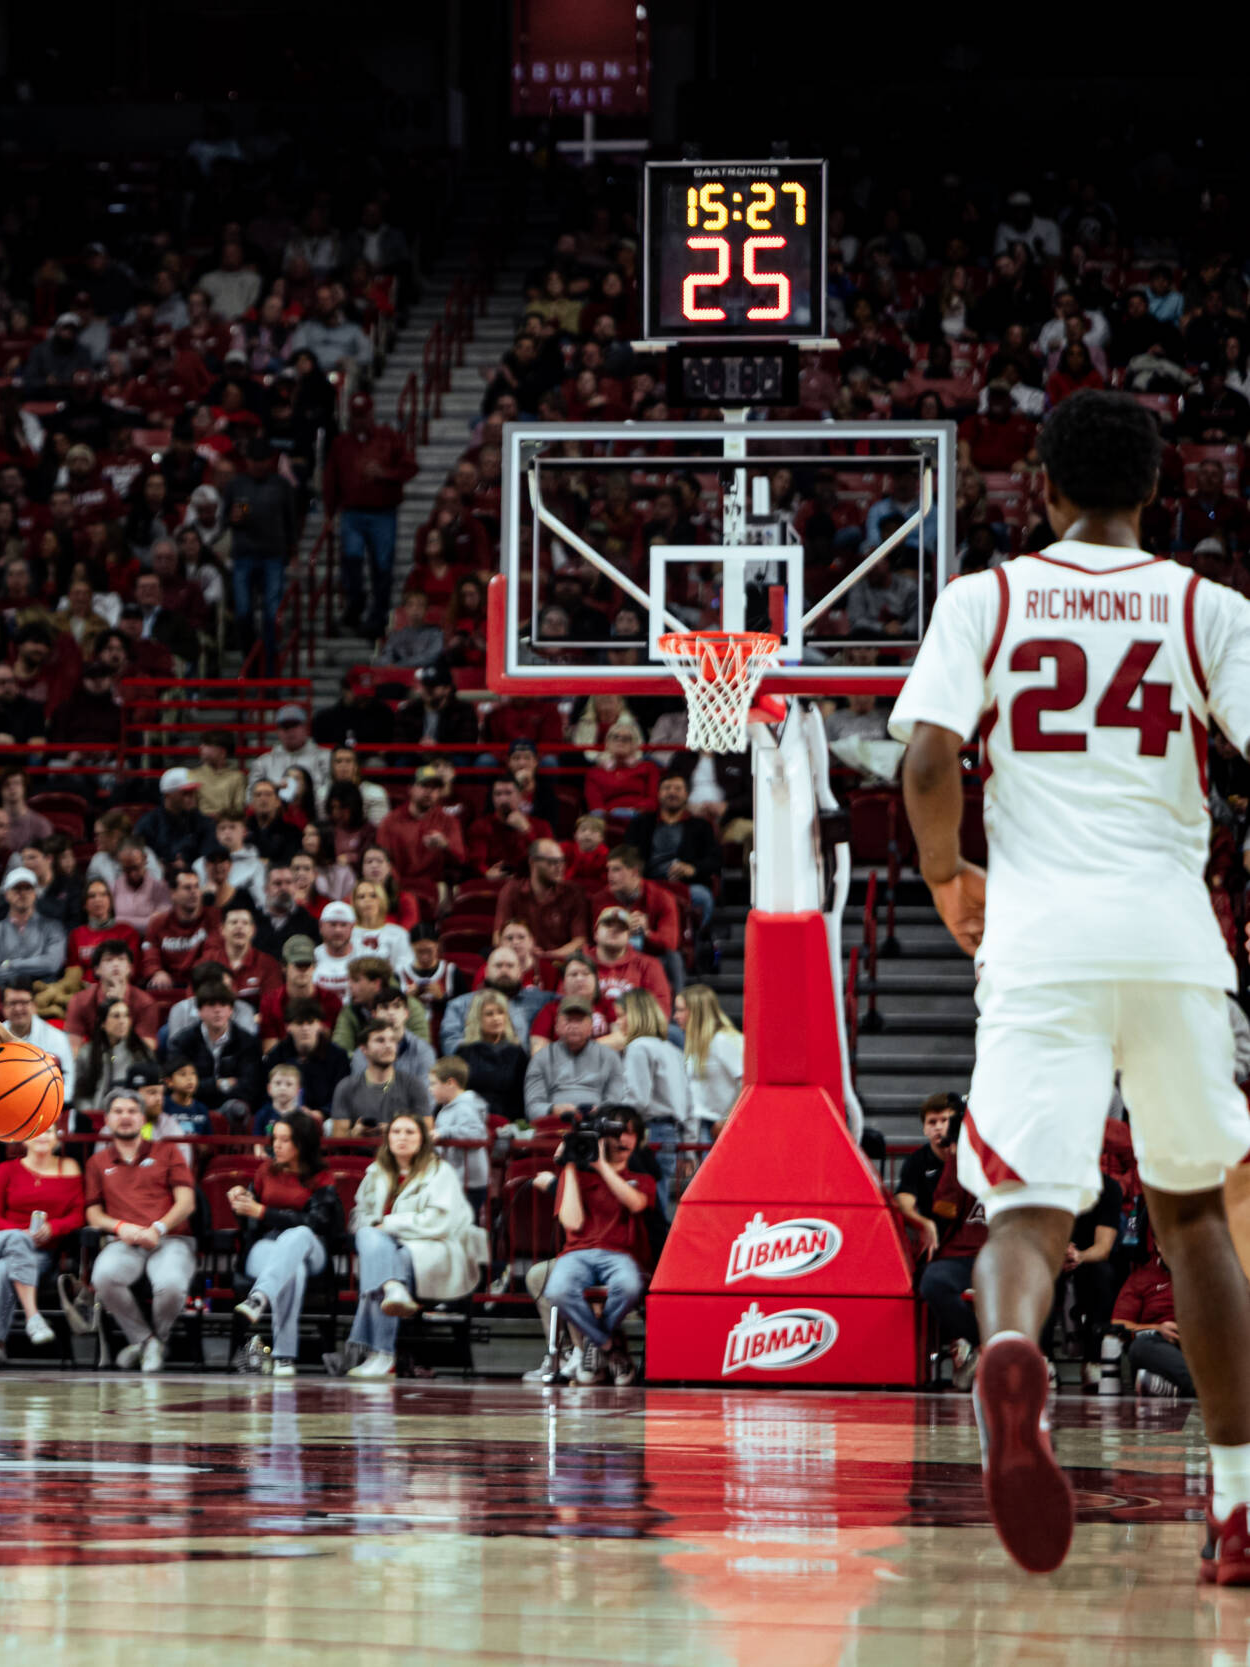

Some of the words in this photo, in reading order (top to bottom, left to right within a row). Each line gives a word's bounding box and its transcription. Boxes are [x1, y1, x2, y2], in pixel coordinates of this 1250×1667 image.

[693, 166, 779, 178] DAKTRONICS
[687, 182, 807, 231] 15:27
[682, 236, 791, 321] 25
[1025, 588, 1142, 623] RICHMOND
[1150, 592, 1169, 624] III
[1009, 638, 1182, 757] 24
[731, 1230, 827, 1276] LIBMAN
[727, 1320, 823, 1366] LIBMAN
